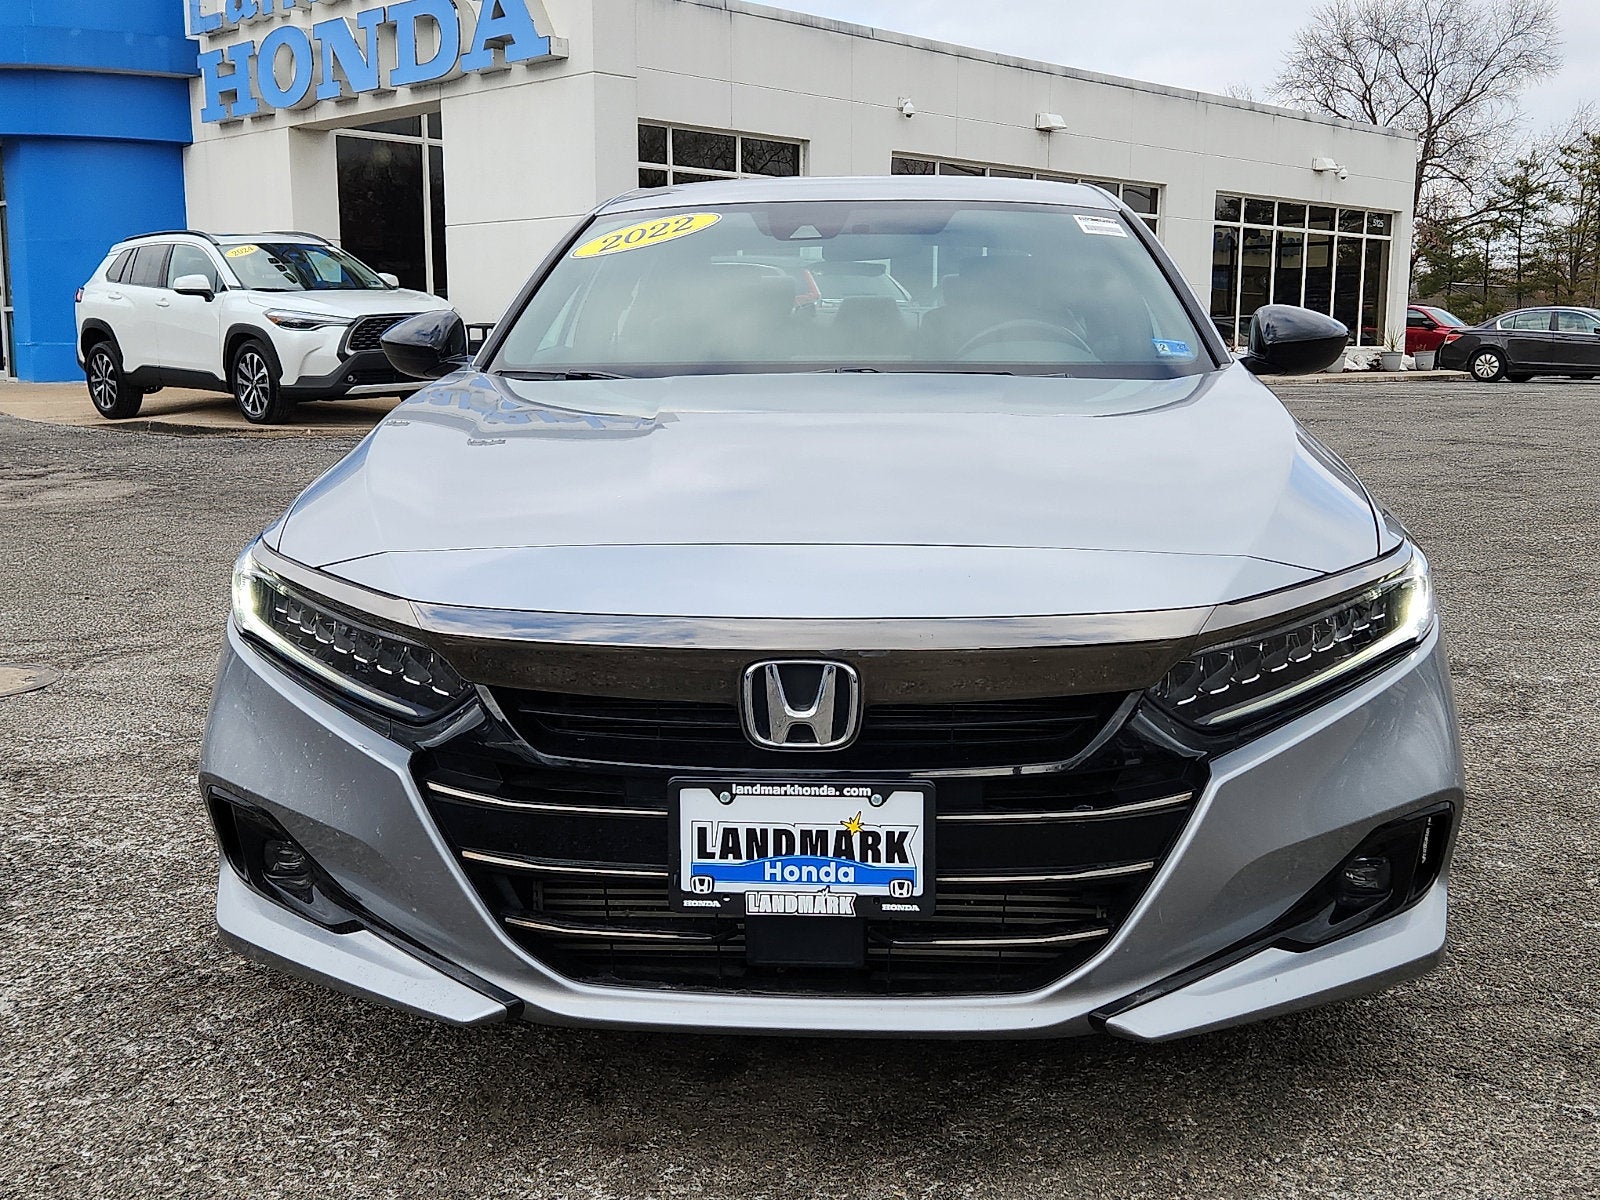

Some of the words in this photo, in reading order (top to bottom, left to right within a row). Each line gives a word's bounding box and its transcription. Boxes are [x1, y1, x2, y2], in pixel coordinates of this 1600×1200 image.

[197, 0, 551, 123] HONDA
[598, 216, 695, 253] 2022
[696, 825, 911, 864] LANDMARK
[764, 861, 856, 883] Honda
[682, 900, 722, 908] HONDA
[748, 893, 853, 915] LANDMARK
[881, 903, 920, 912] HONDA
